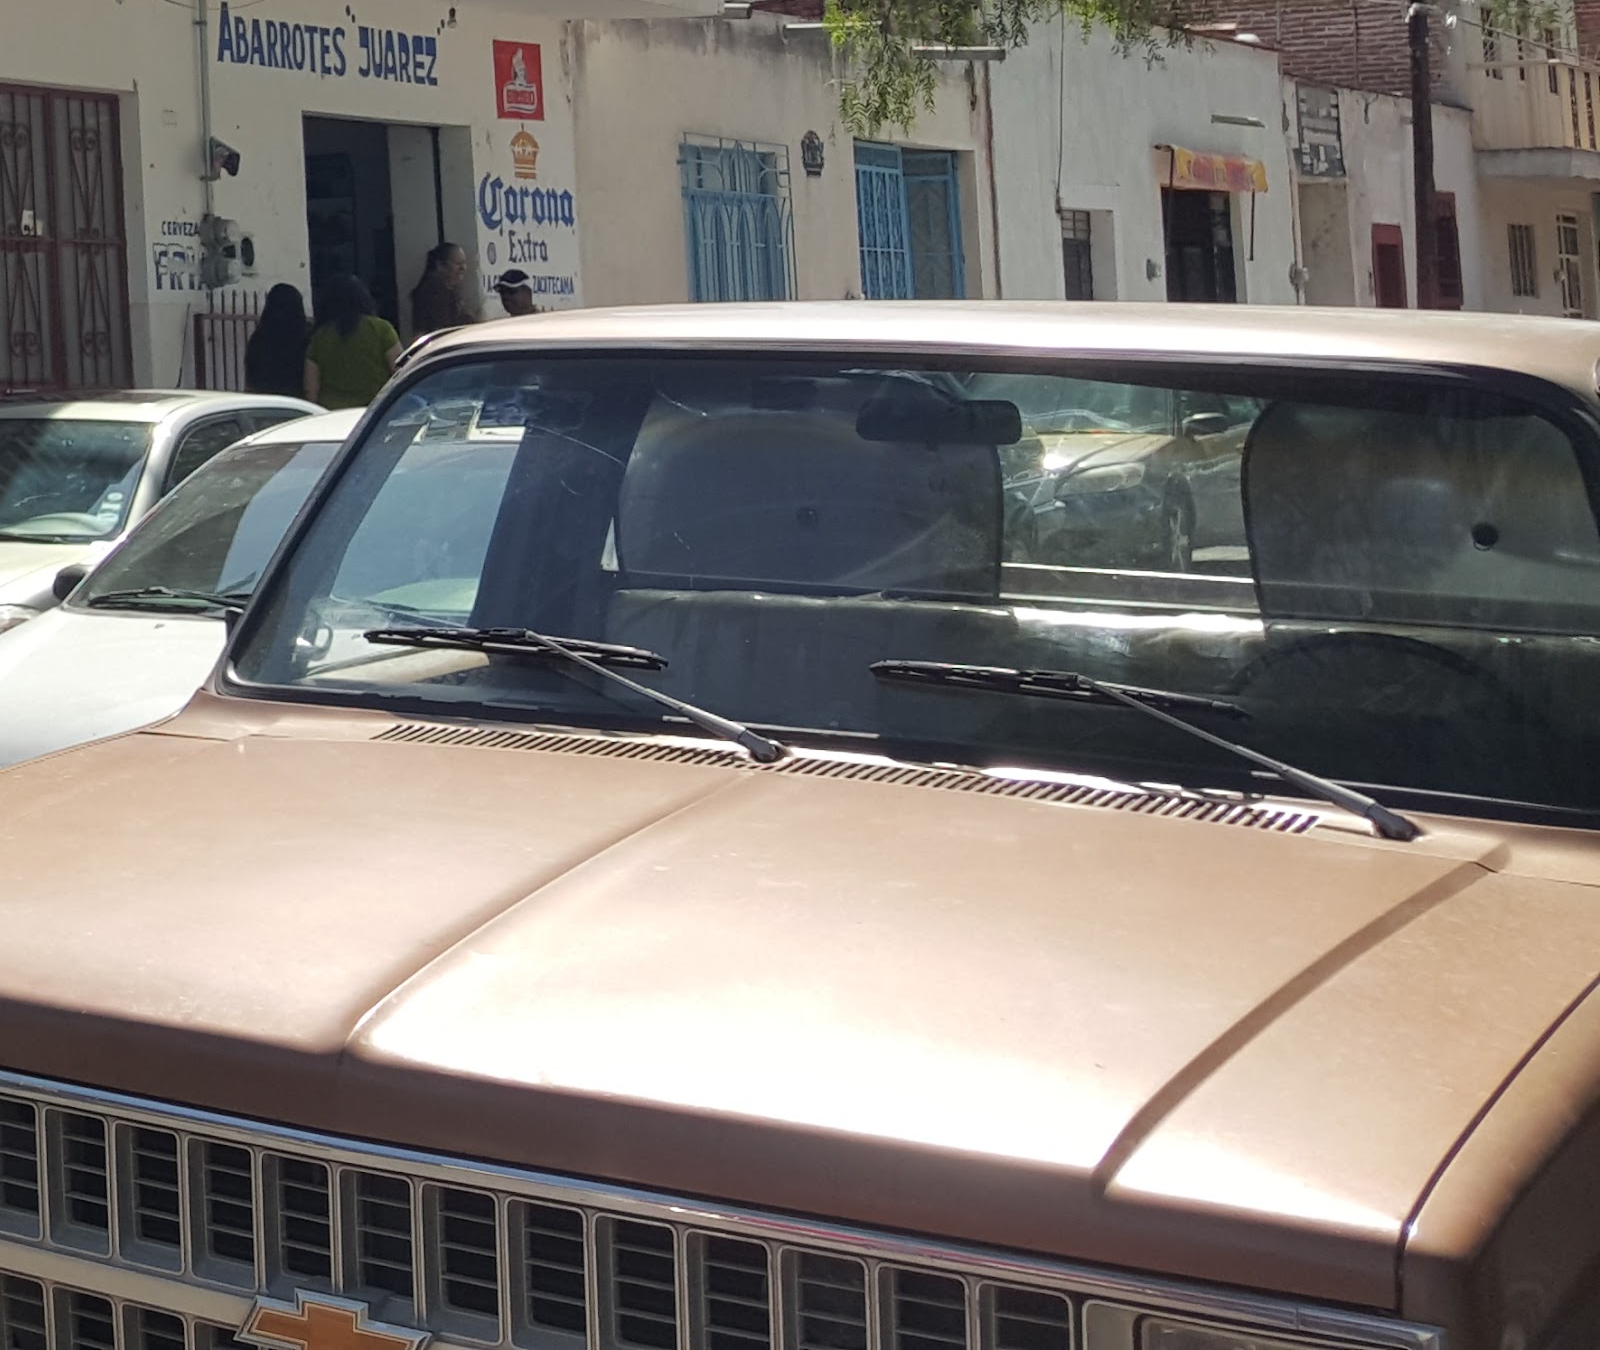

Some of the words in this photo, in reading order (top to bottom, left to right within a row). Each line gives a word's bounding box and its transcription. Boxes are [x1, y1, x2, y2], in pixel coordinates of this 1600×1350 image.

[217, 1, 347, 77] ABARROTES
[479, 172, 574, 237] Corona
[509, 230, 548, 263] Extra
